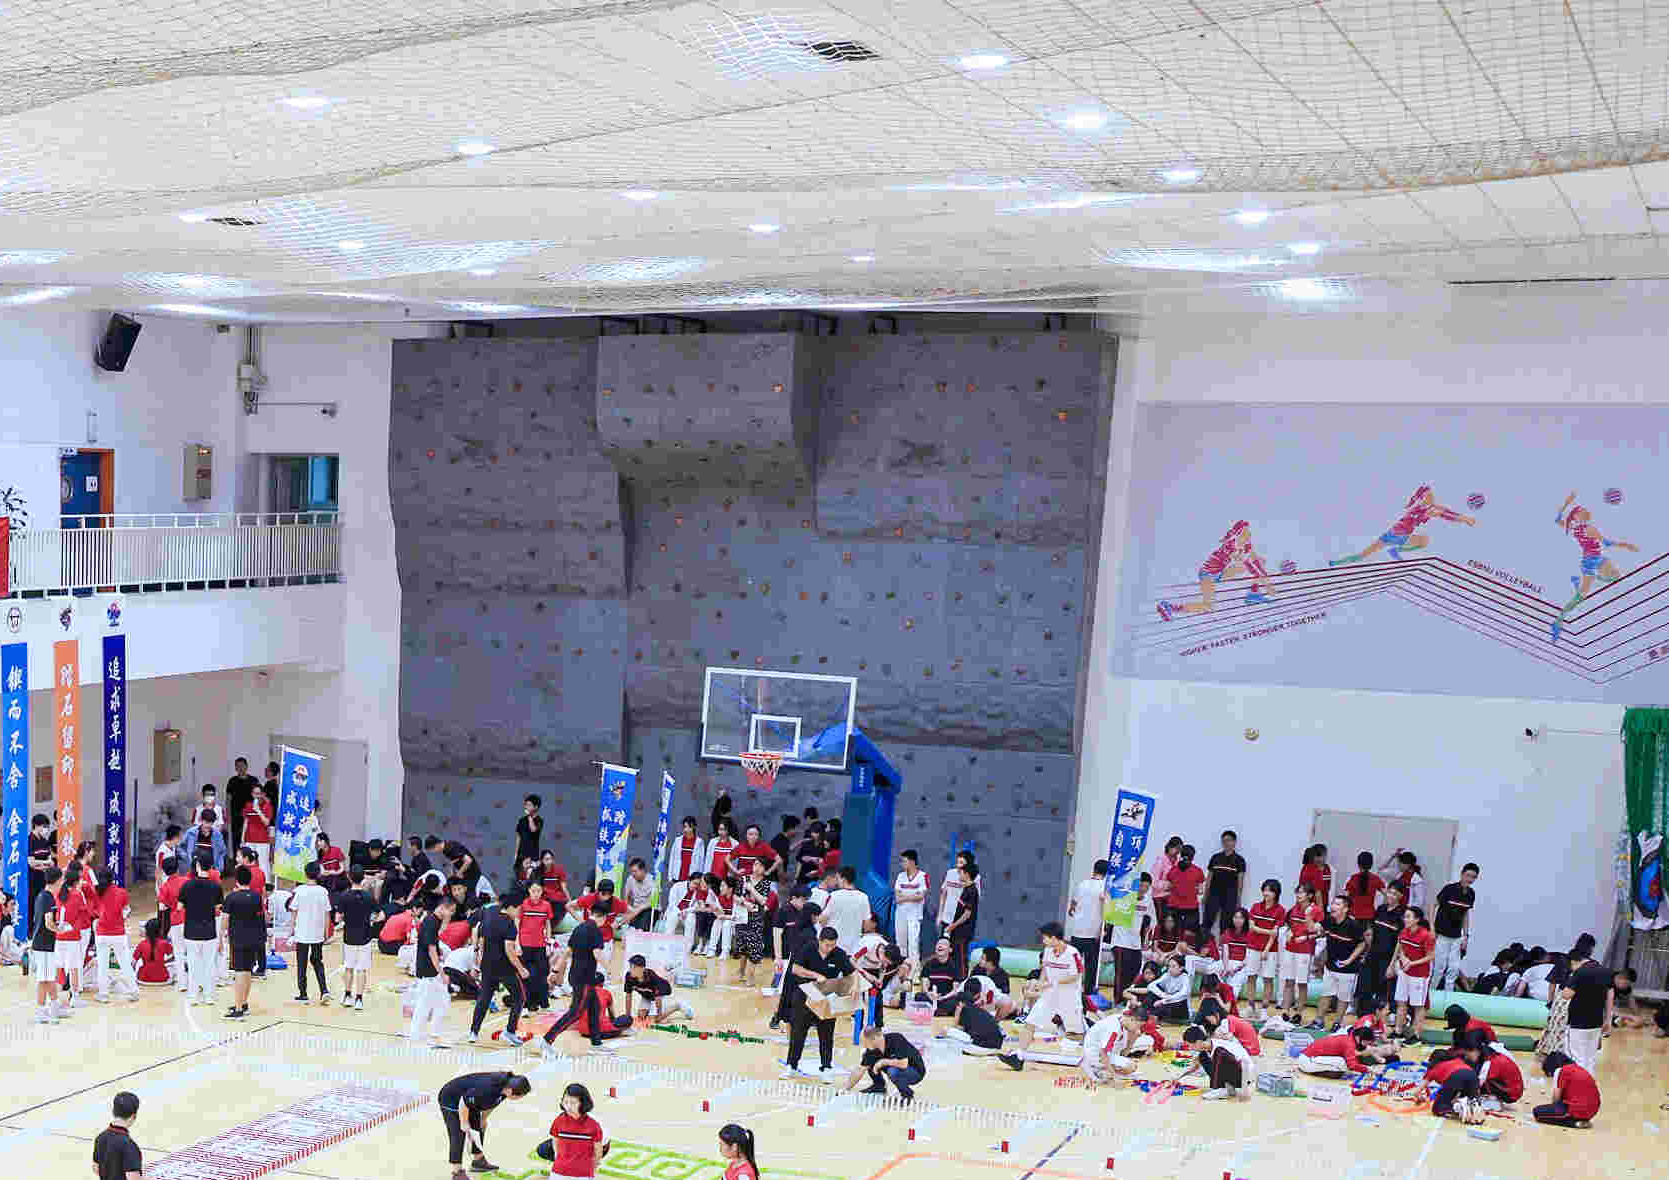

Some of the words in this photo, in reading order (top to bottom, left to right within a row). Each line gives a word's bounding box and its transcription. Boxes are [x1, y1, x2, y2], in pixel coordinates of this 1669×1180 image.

[6, 665, 24, 791] 锲而不舍
[107, 655, 123, 772] 追求卓越
